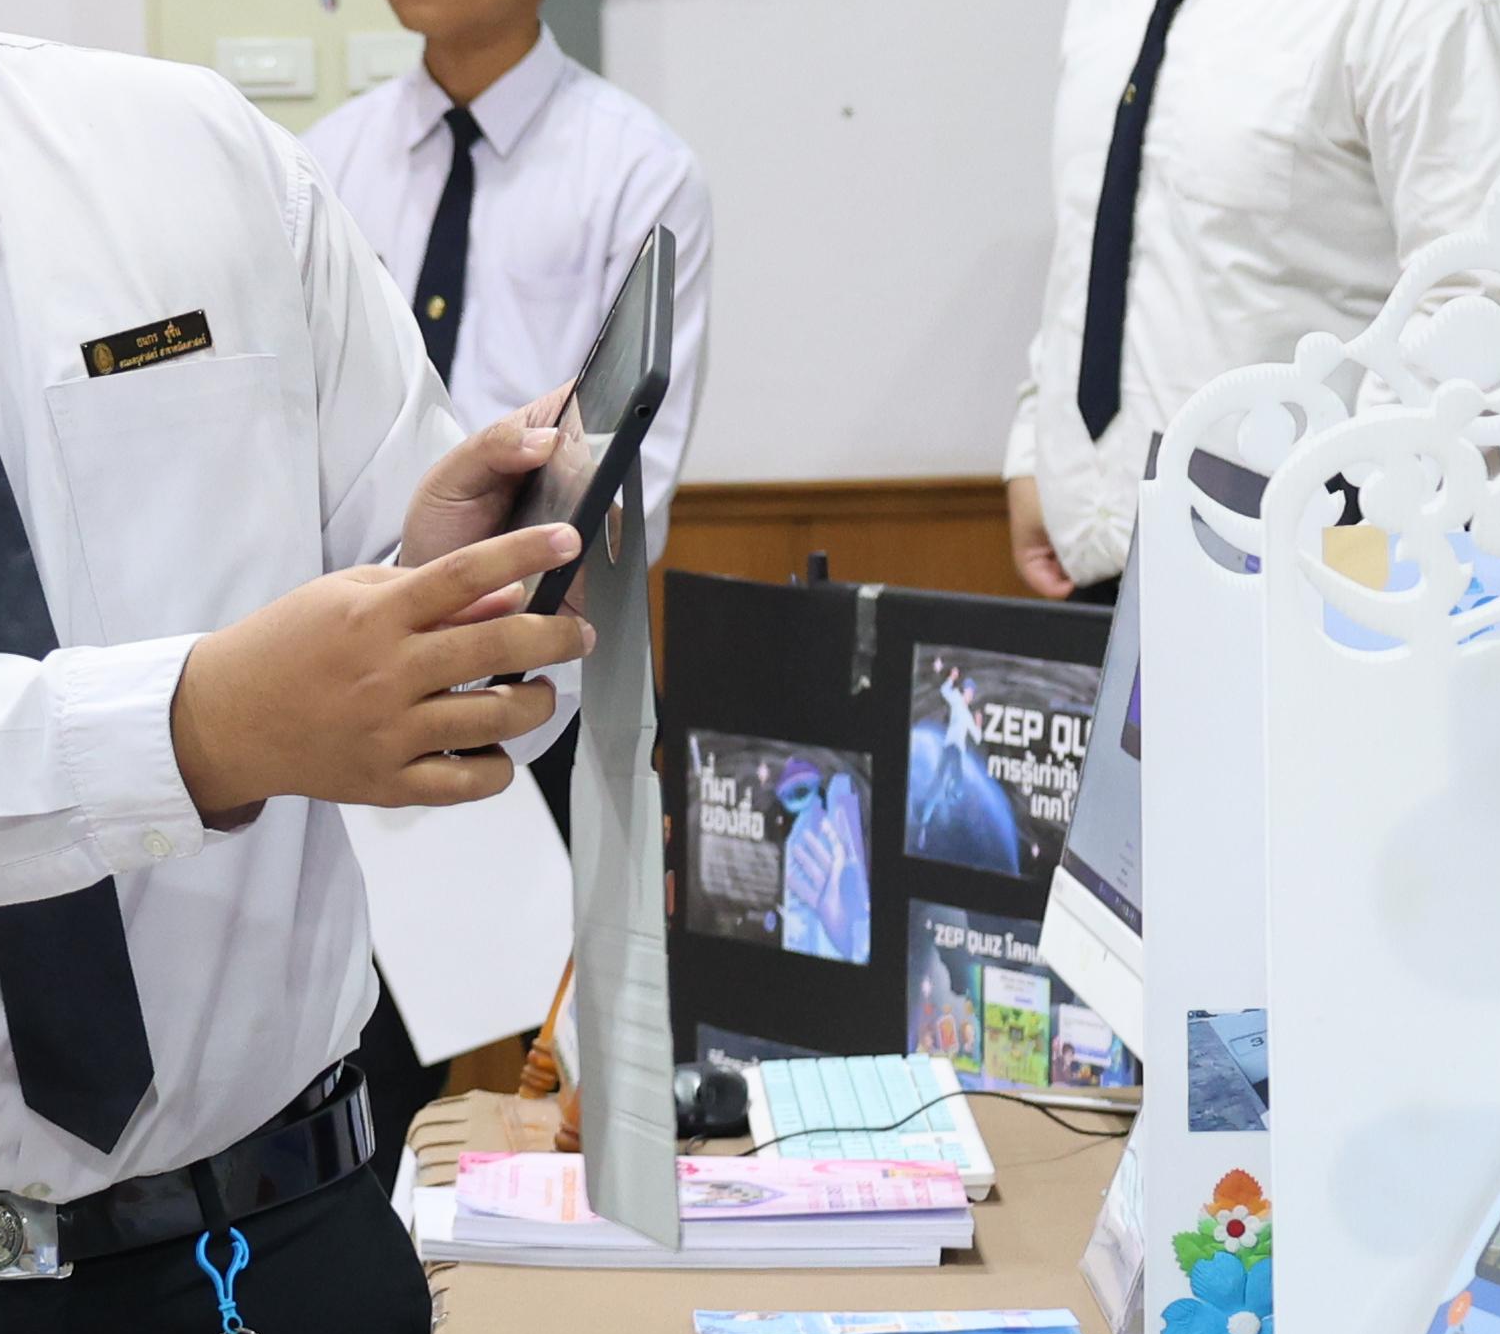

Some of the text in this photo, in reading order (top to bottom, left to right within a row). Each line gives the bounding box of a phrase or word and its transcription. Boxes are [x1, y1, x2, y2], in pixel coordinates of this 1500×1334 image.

[984, 703, 1044, 747] ZEP
[701, 752, 737, 805] ที่มา
[701, 786, 765, 841] ของสื่อ
[934, 923, 964, 948] ZEP
[967, 930, 1002, 957] QUIZ
